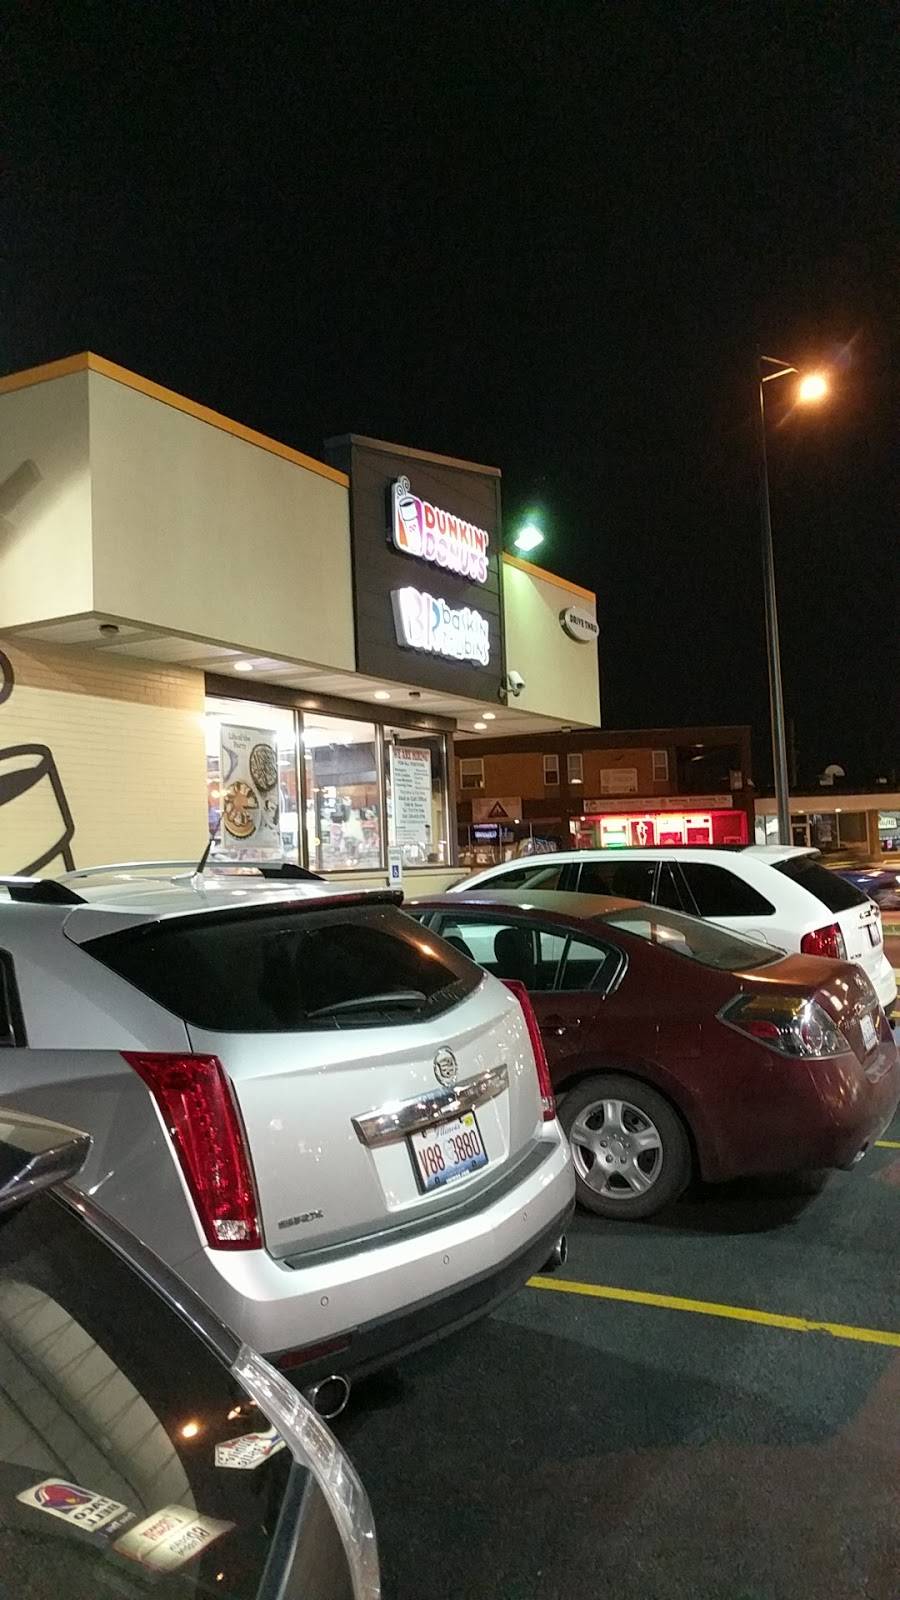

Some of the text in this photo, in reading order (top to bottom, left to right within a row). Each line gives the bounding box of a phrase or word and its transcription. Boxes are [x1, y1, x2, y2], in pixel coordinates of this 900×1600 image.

[424, 503, 488, 553] DUNKIN'
[425, 532, 487, 581] DONUTS
[418, 1143, 445, 1177] V88
[448, 1129, 481, 1164] 3880
